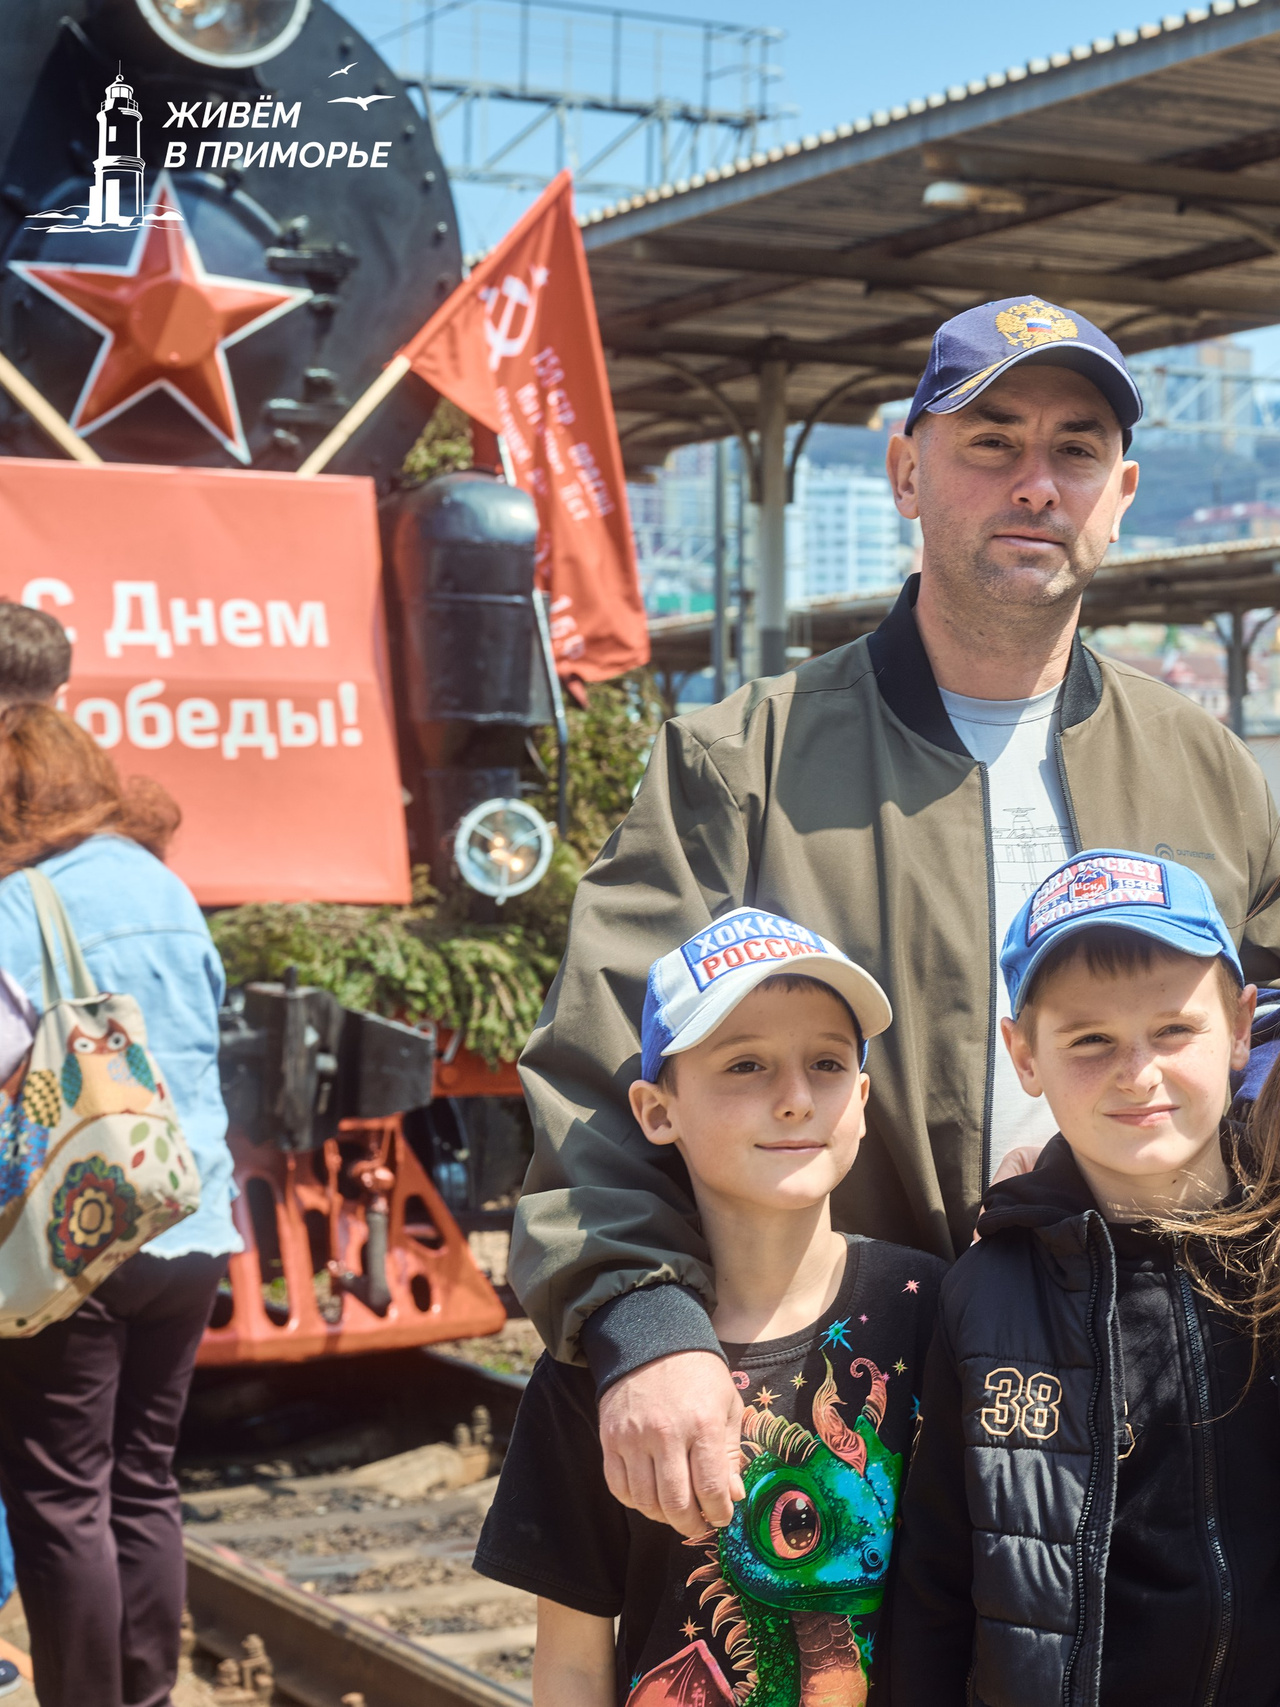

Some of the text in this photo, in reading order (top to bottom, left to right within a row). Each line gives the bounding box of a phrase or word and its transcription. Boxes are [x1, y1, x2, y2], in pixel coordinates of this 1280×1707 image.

[104, 580, 330, 658] Днем
[56, 679, 363, 760] обеды!
[694, 916, 815, 956] ХОККЕЙ
[981, 1367, 1063, 1440] 38
